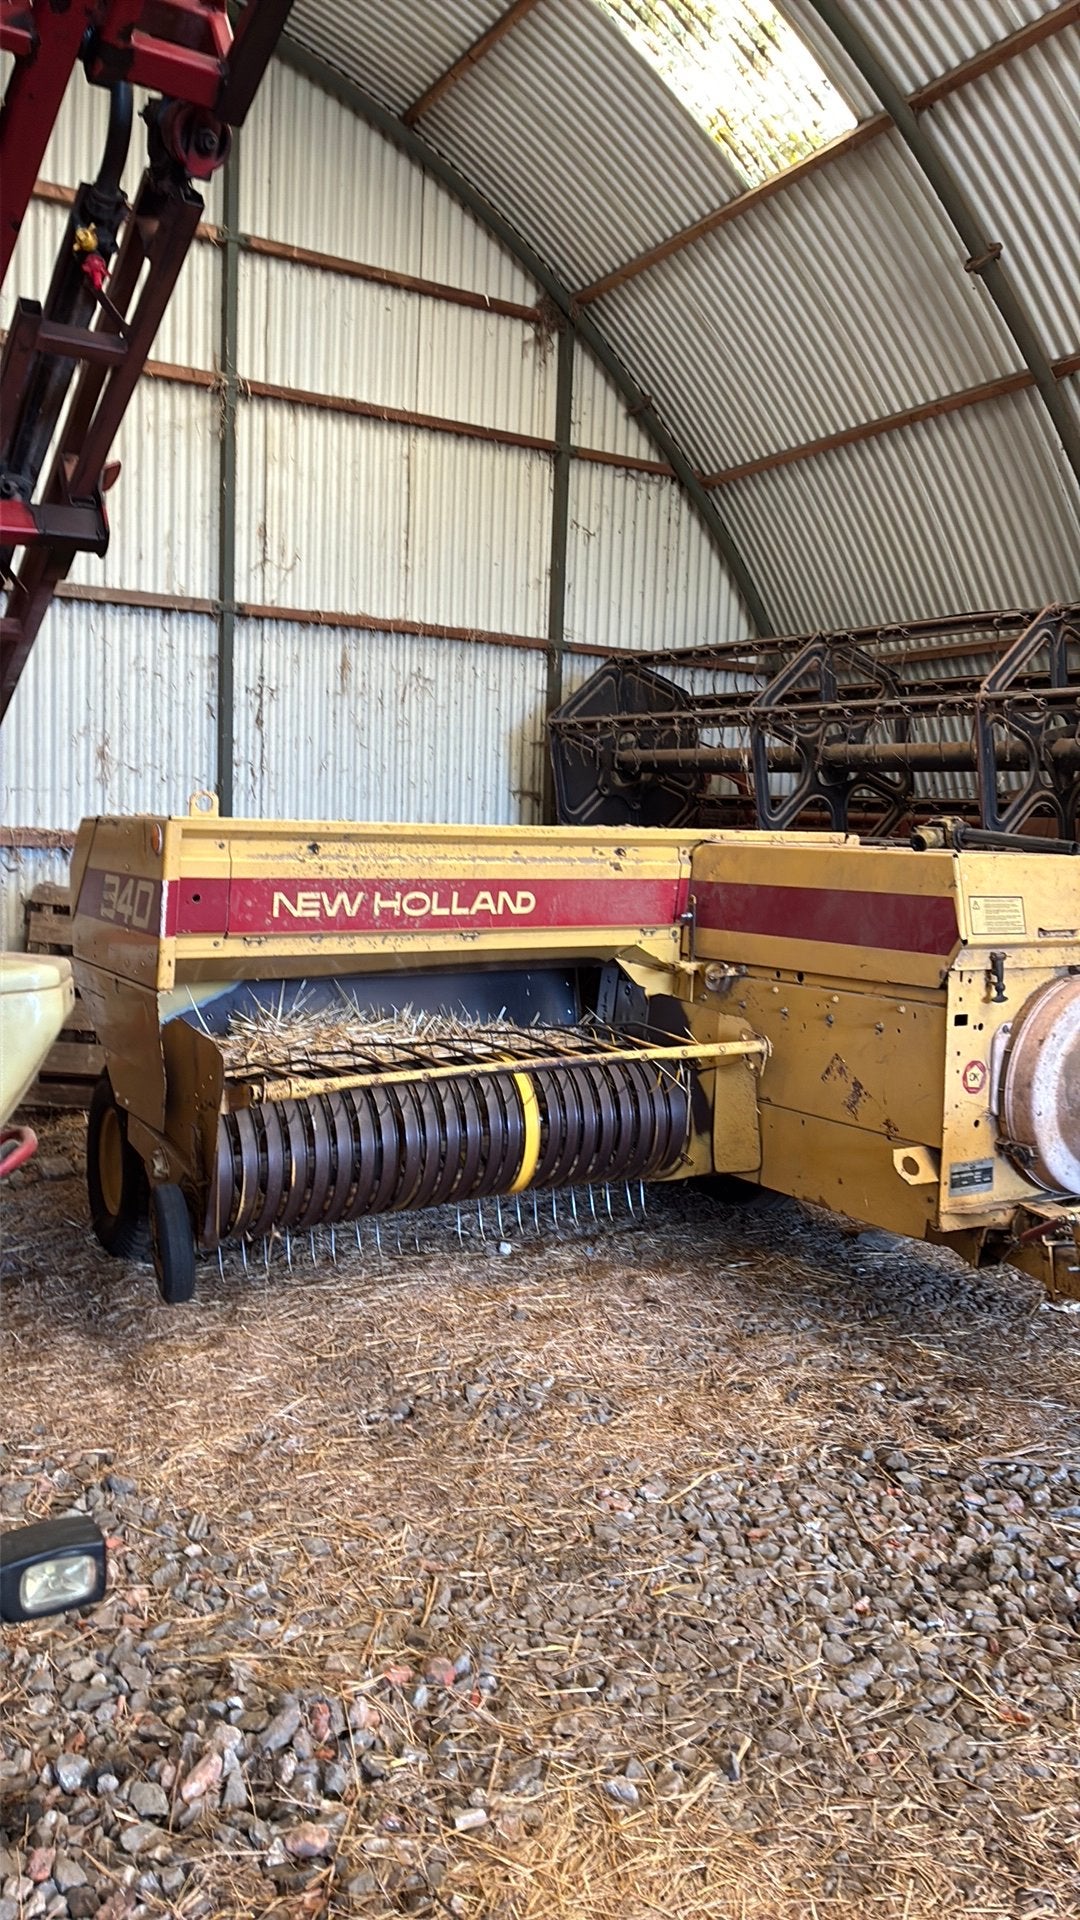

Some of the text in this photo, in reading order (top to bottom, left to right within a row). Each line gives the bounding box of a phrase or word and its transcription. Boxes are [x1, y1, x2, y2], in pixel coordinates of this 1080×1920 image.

[100, 873, 155, 929] 340
[272, 890, 537, 918] NEW HOLLAND
